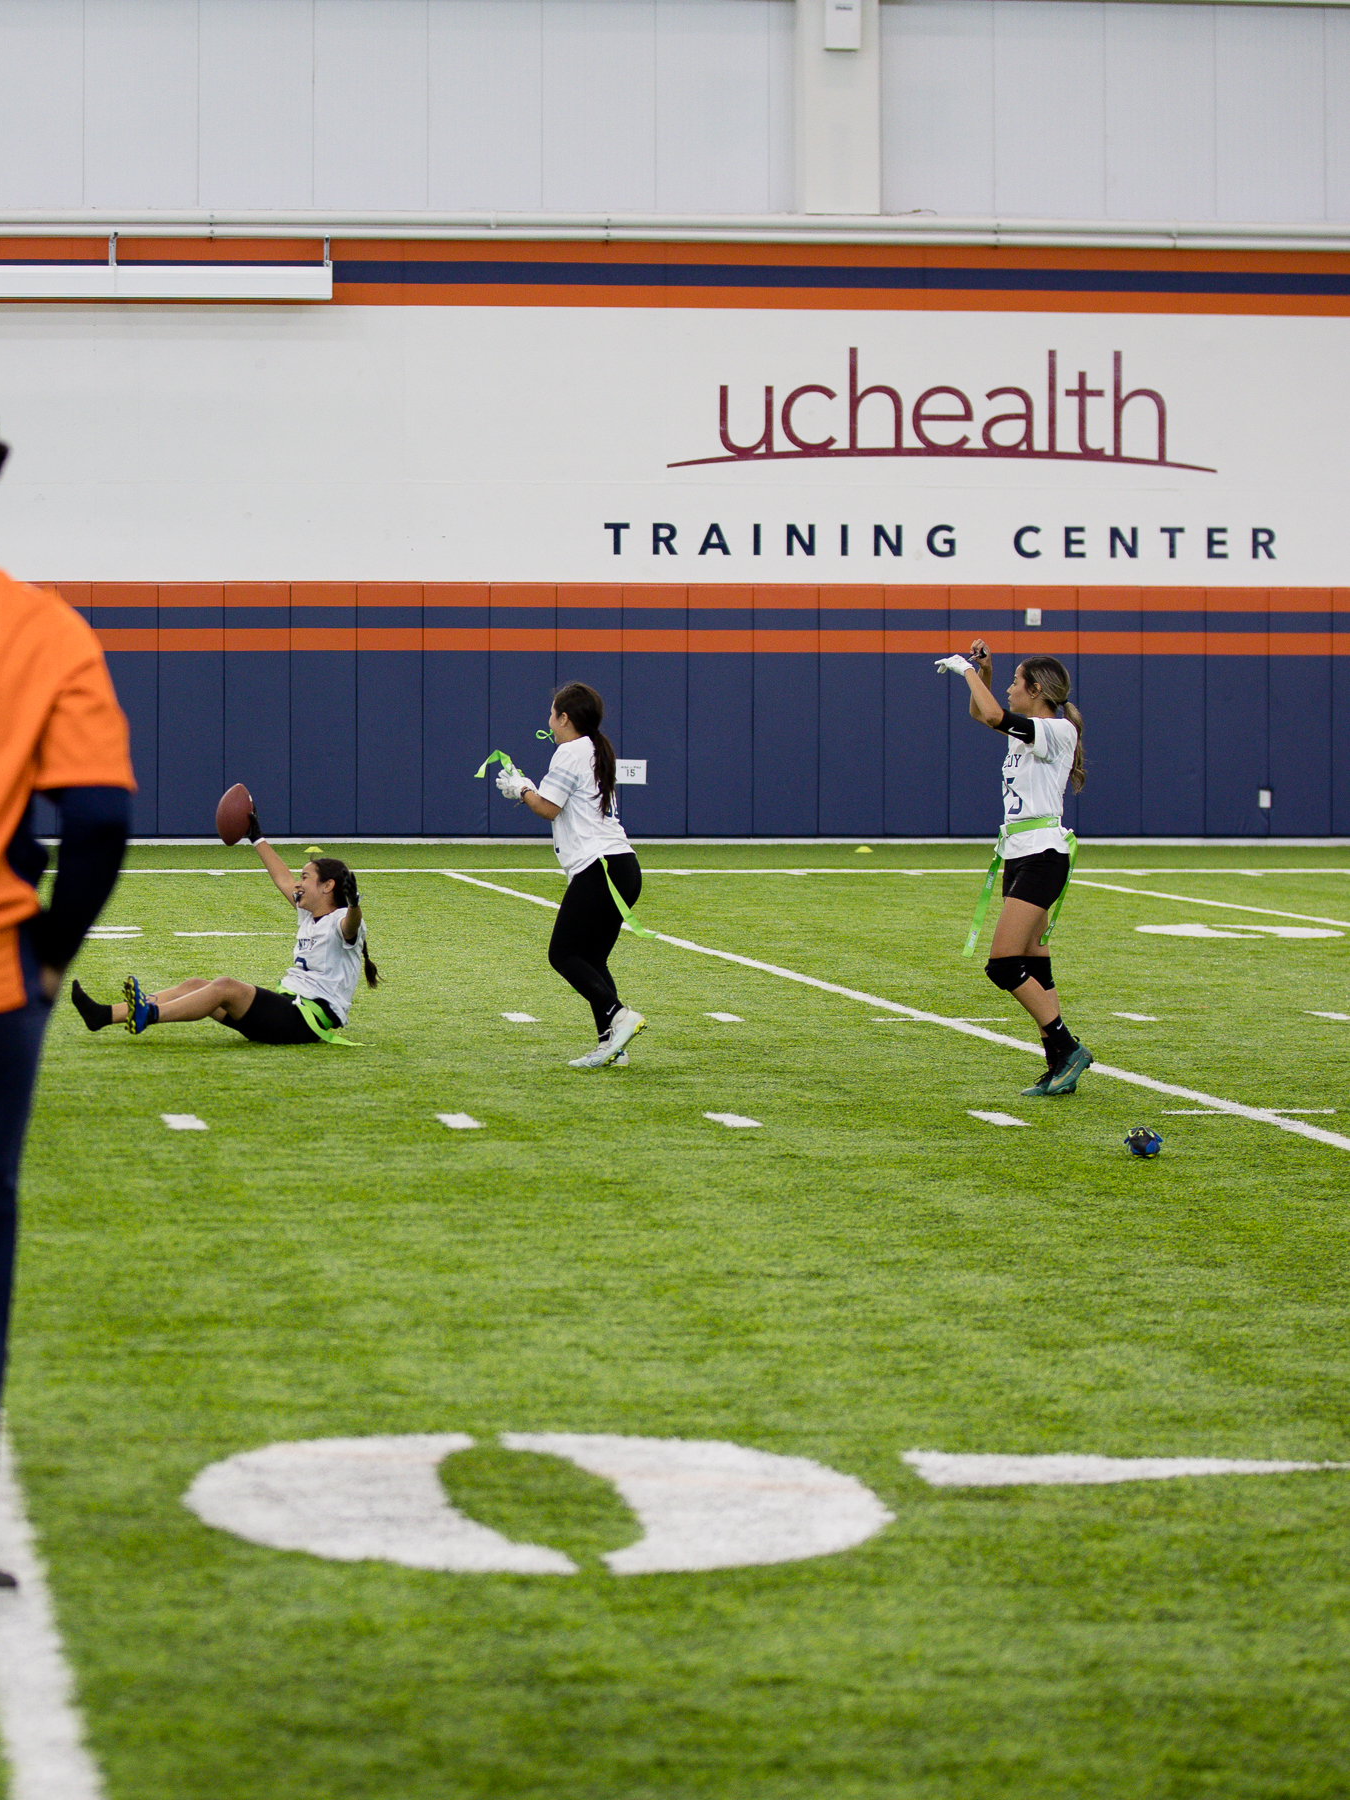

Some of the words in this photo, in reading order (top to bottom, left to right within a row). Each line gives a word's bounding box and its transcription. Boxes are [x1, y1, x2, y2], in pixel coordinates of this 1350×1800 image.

[719, 347, 1168, 463] uchealth
[604, 522, 959, 558] TRAINING
[1013, 525, 1278, 560] CENTER
[626, 769, 636, 778] 15
[1002, 776, 1023, 815] 5
